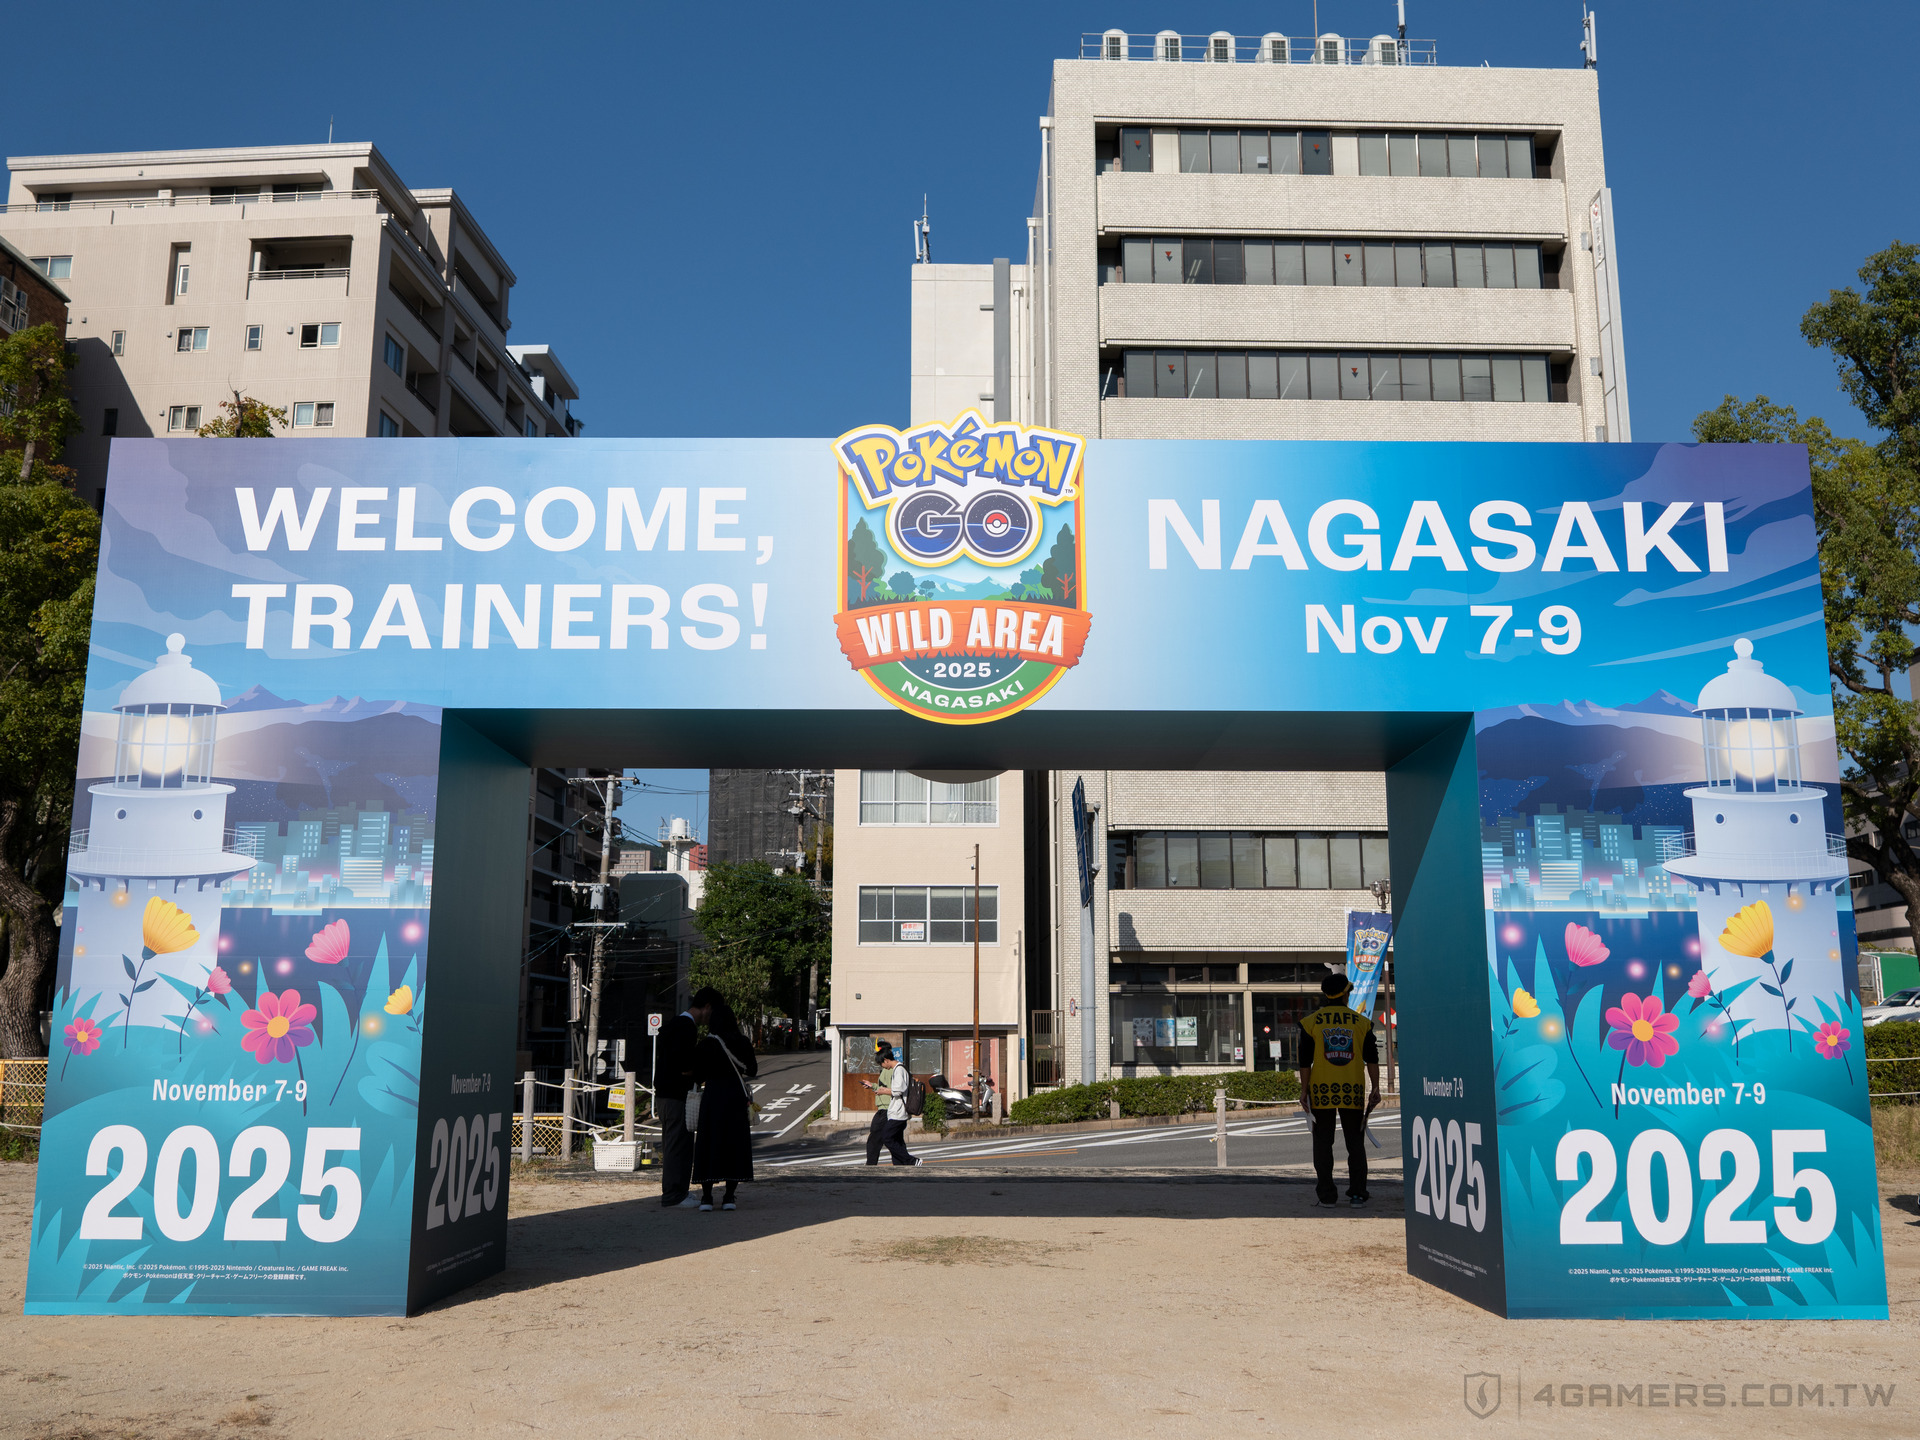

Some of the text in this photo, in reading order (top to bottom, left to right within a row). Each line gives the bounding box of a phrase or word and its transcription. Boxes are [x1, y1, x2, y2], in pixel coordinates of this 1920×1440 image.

[842, 416, 1076, 499] Pokémon
[234, 485, 775, 566] WELCOME,
[894, 488, 1033, 559] GO
[1147, 498, 1729, 573] NAGASAKI
[230, 582, 769, 651] TRAINERS!
[855, 606, 1065, 658] WILD AREA
[1304, 603, 1582, 655] Nov 7-9
[932, 661, 992, 679] 2025
[900, 679, 1025, 710] NAGASAKI
[1367, 955, 1379, 963] ARE
[1315, 1012, 1360, 1025] STAFF
[1326, 1051, 1352, 1059] WILD AREA
[152, 1078, 308, 1102] November 7-9
[450, 1072, 491, 1095] November 7-9
[1423, 1076, 1464, 1099] November 7-9
[1611, 1082, 1766, 1105] November 7-9
[79, 1124, 362, 1243] 2025
[426, 1112, 502, 1231] 2025
[1411, 1115, 1487, 1233] 2025
[1555, 1128, 1837, 1246] 2025
[104, 1263, 126, 1271] Niantic,
[1589, 1268, 1611, 1276] Niantic,
[1674, 1267, 1710, 1275] ©1995-2025
